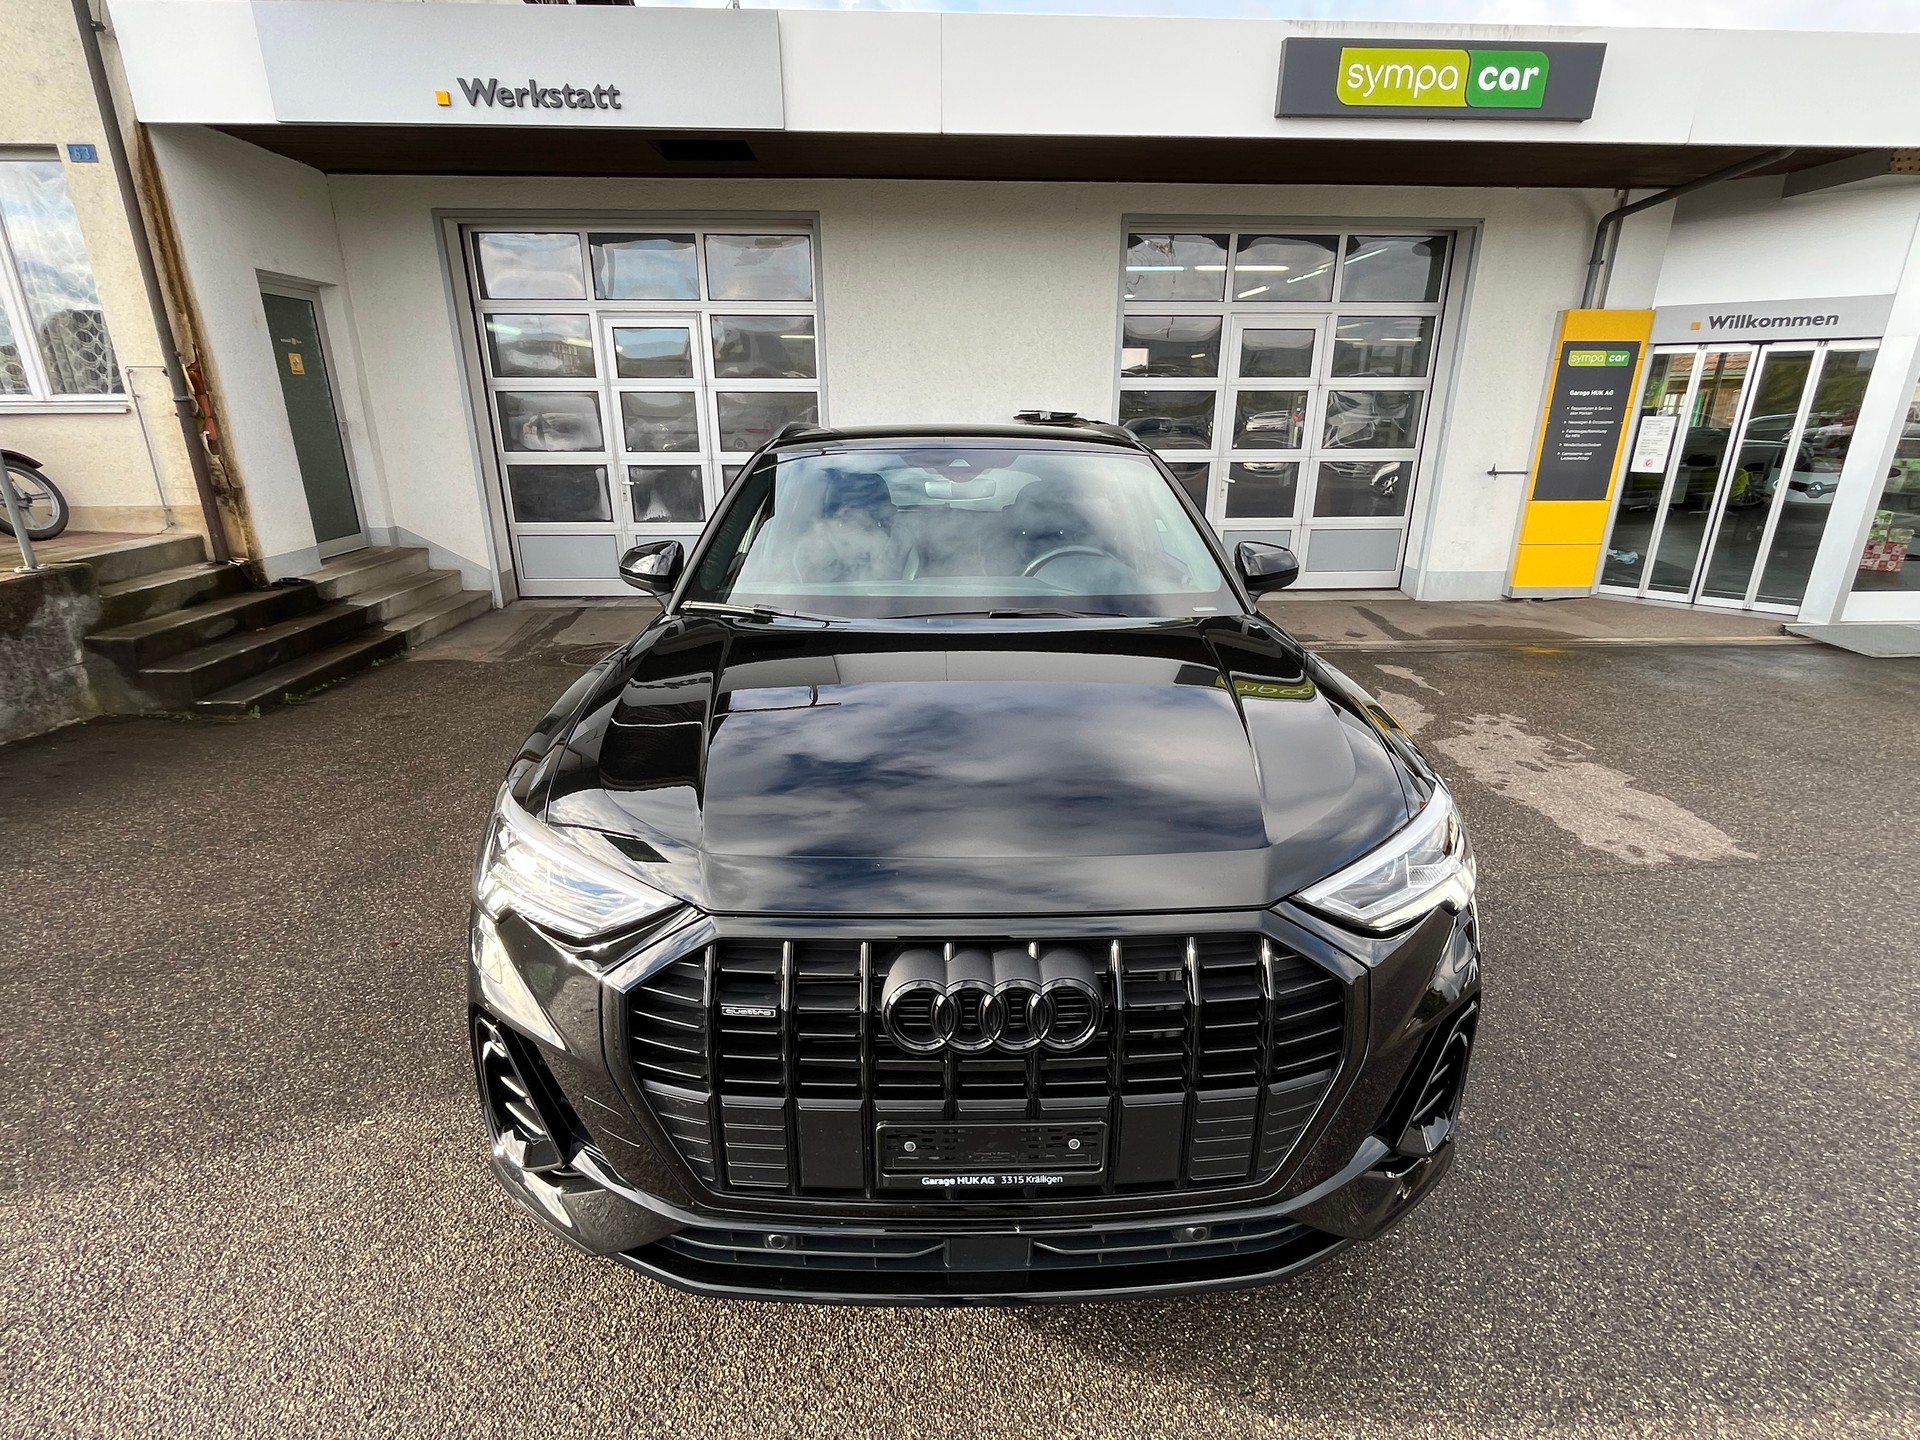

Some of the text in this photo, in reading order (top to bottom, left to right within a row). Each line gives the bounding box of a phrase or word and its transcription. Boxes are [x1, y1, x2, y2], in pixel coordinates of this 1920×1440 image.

[1346, 63, 1540, 98] sympa car
[456, 77, 622, 110] Werkstatt
[1708, 314, 1840, 330] Willkommen
[1570, 354, 1628, 364] sympa car
[921, 1177, 956, 1187] Garage
[957, 1176, 980, 1185] HUK
[980, 1176, 996, 1185] AG
[1001, 1176, 1025, 1184] 3315
